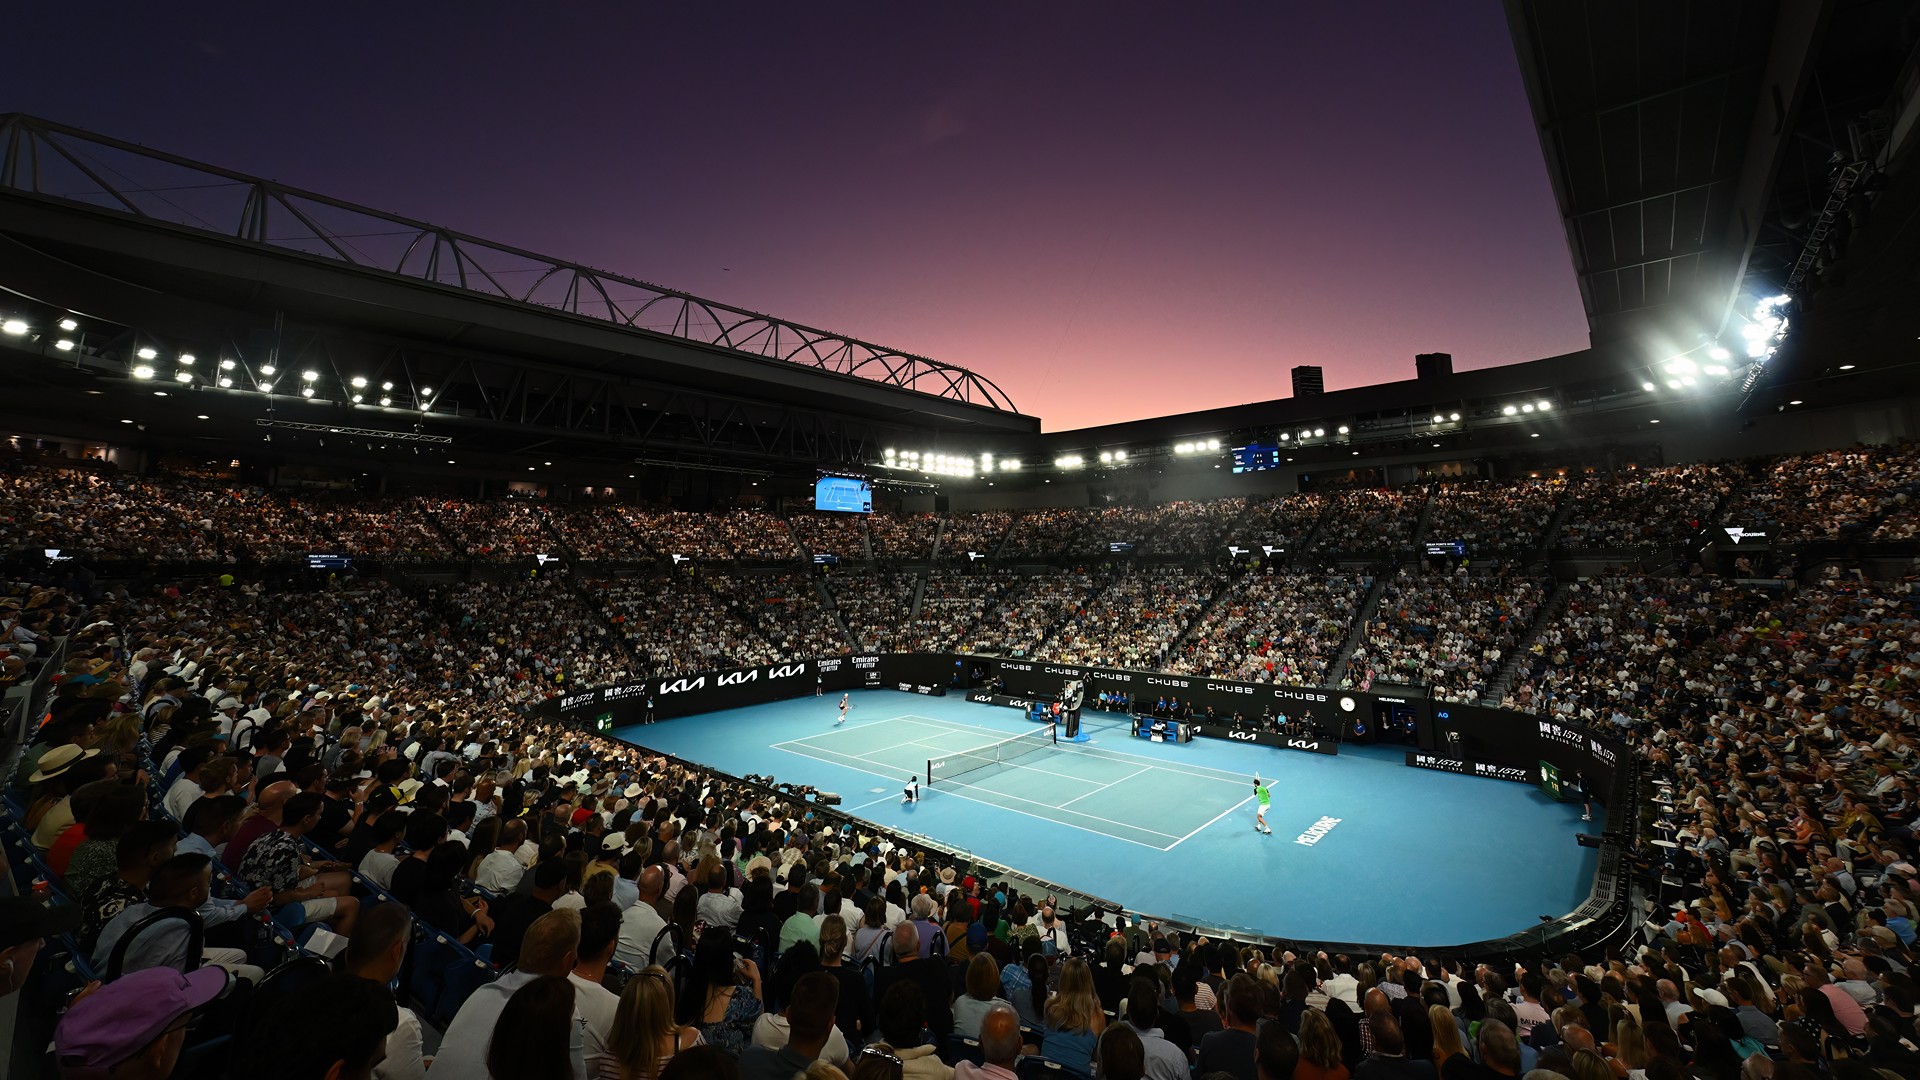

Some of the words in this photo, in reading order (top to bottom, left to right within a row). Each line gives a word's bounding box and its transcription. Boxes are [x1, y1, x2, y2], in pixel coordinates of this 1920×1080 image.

[817, 658, 842, 668] Emirates
[851, 655, 880, 664] Emirates
[769, 663, 805, 679] KIA
[1001, 662, 1032, 672] CHUBB
[1044, 667, 1079, 676] CHUBB
[717, 669, 758, 687] KIA
[1093, 672, 1132, 682] CHUBB
[1147, 677, 1190, 688] CHUBB
[660, 676, 705, 695] KIA
[1207, 683, 1254, 694] CHUBB
[974, 694, 992, 703] KIA
[1274, 690, 1327, 702] CHUBB
[1437, 711, 1449, 719] AO
[1228, 730, 1257, 741] KIA
[1287, 738, 1319, 750] KIA
[1292, 815, 1343, 847] MELBOURNE
